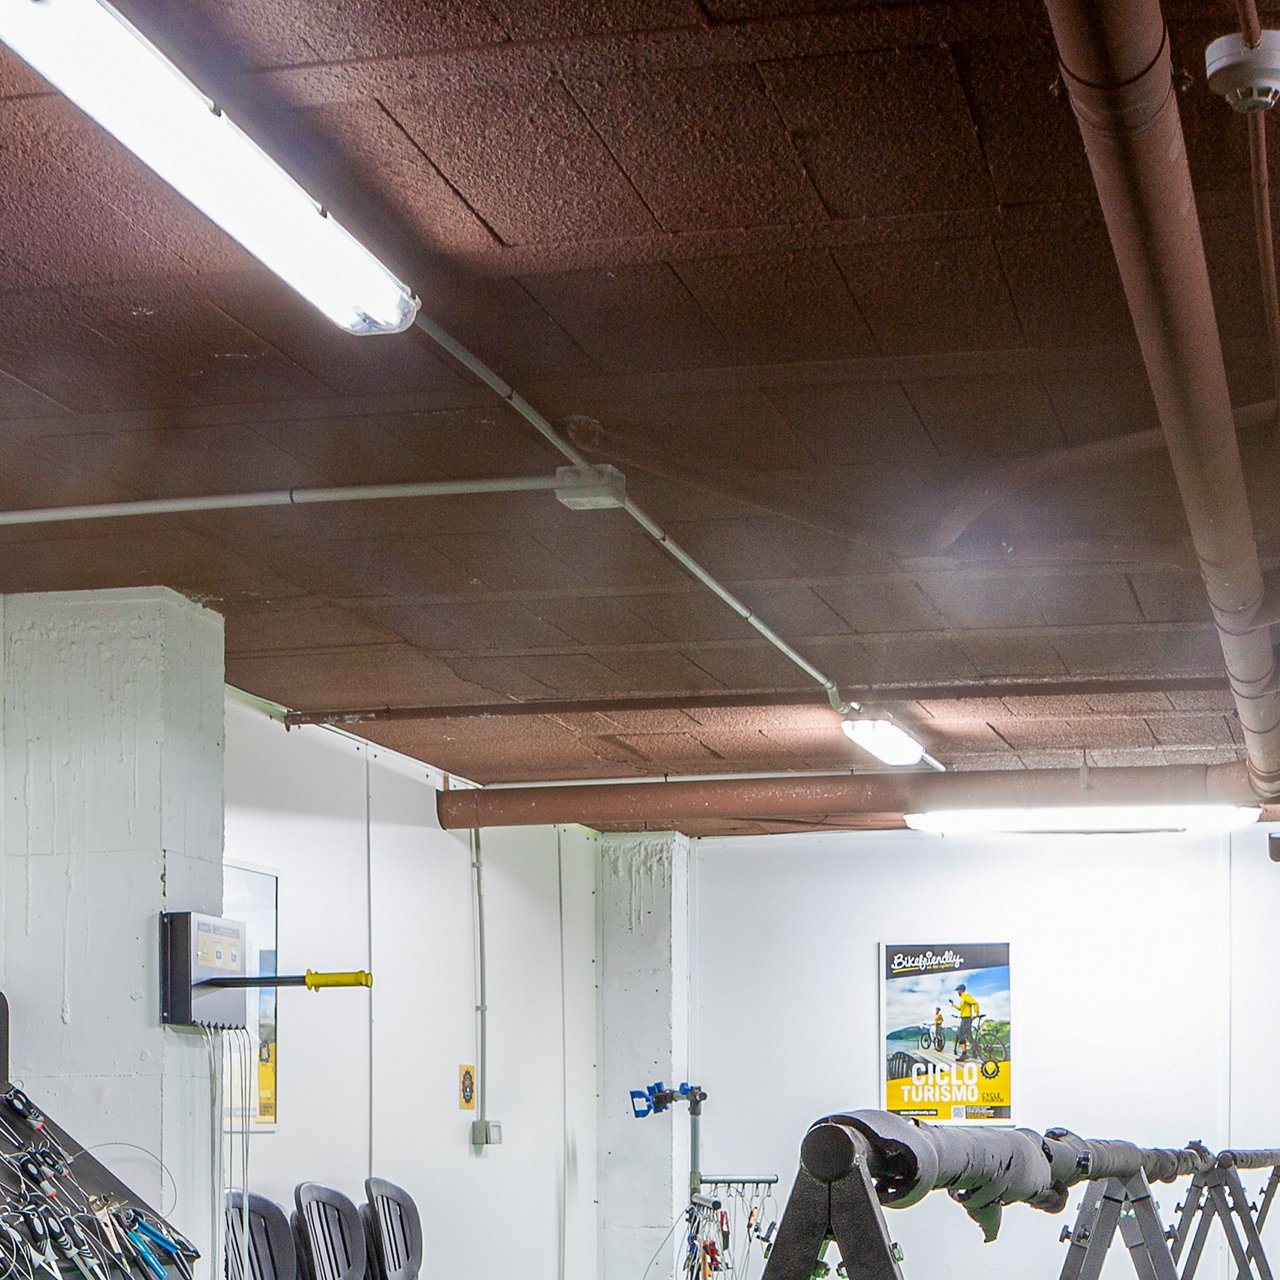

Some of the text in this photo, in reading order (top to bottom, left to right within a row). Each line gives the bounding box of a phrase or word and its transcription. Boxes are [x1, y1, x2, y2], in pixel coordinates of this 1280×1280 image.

[891, 950, 964, 970] Bikefriendly
[912, 1062, 978, 1086] CICLO
[901, 1085, 979, 1103] TURISMO
